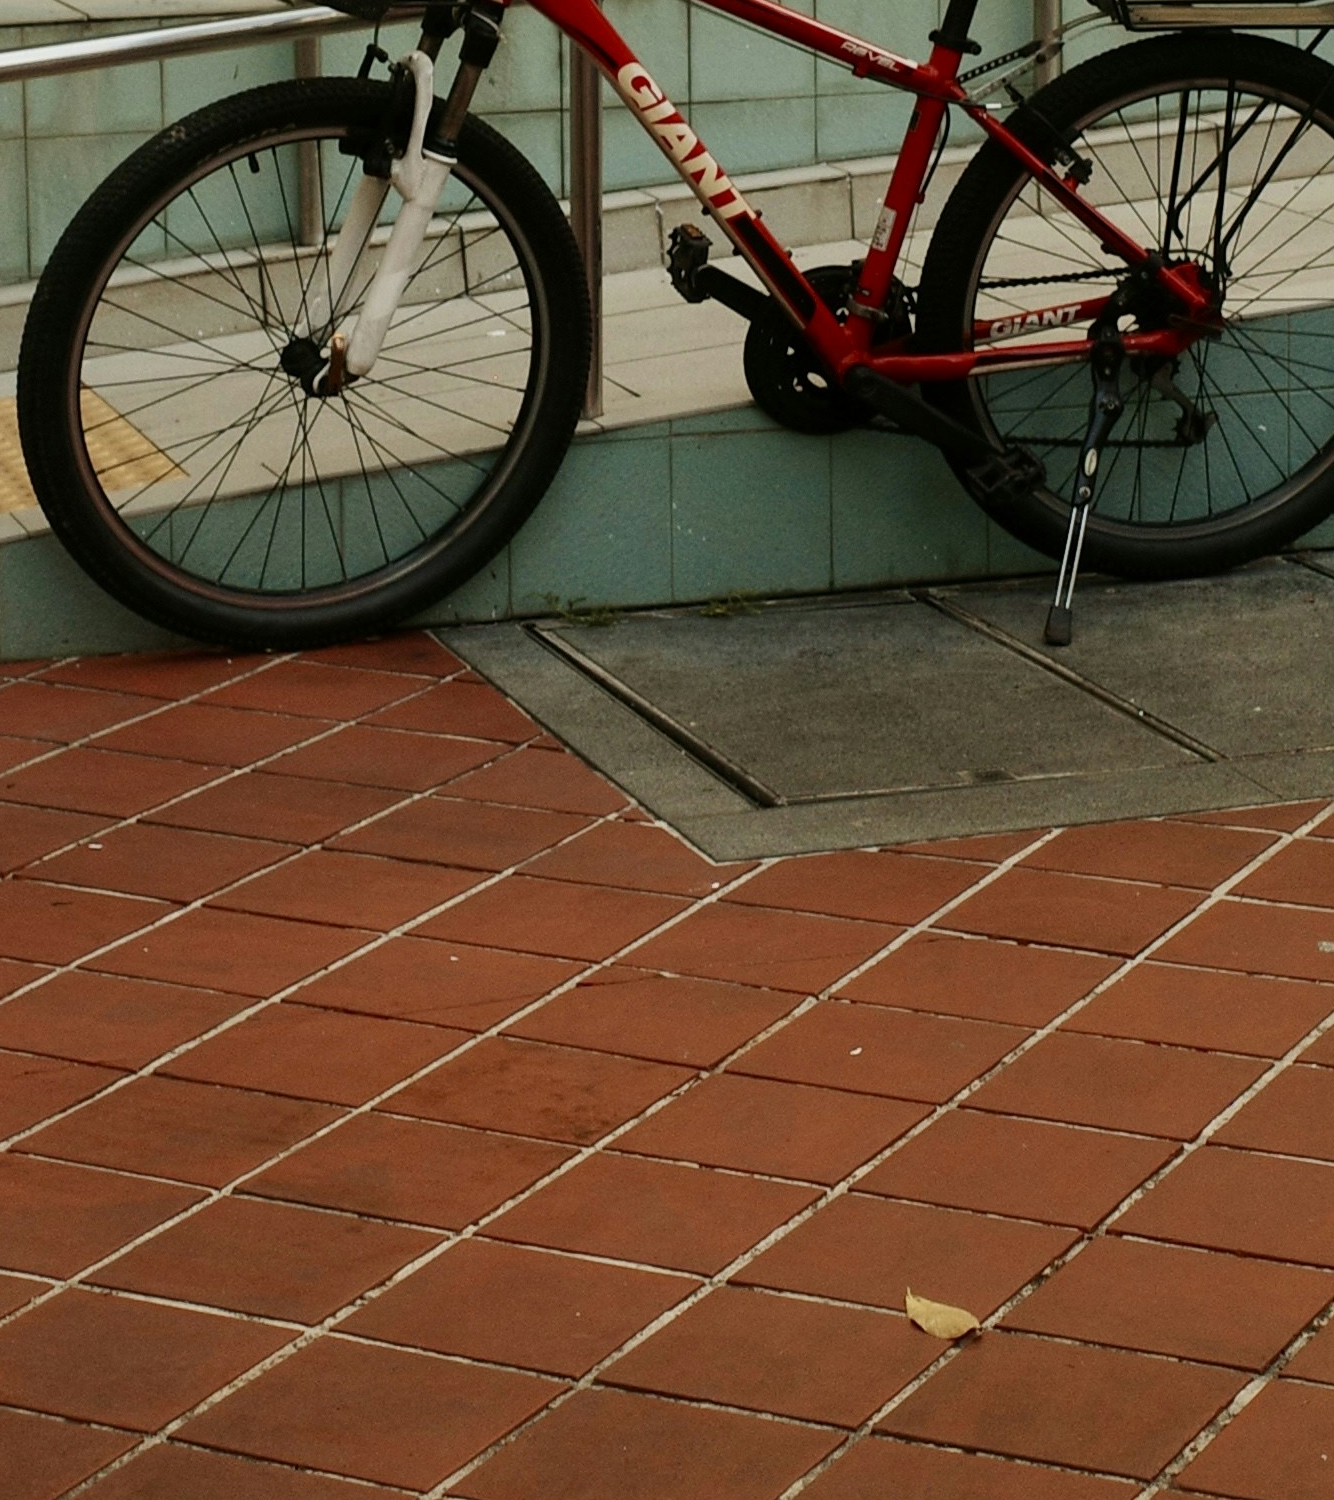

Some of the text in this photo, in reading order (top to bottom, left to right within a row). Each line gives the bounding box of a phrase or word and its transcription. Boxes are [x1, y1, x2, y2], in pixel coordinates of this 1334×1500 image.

[839, 41, 900, 73] REVEL
[617, 61, 757, 221] GIANT
[989, 304, 1082, 338] GIANT
